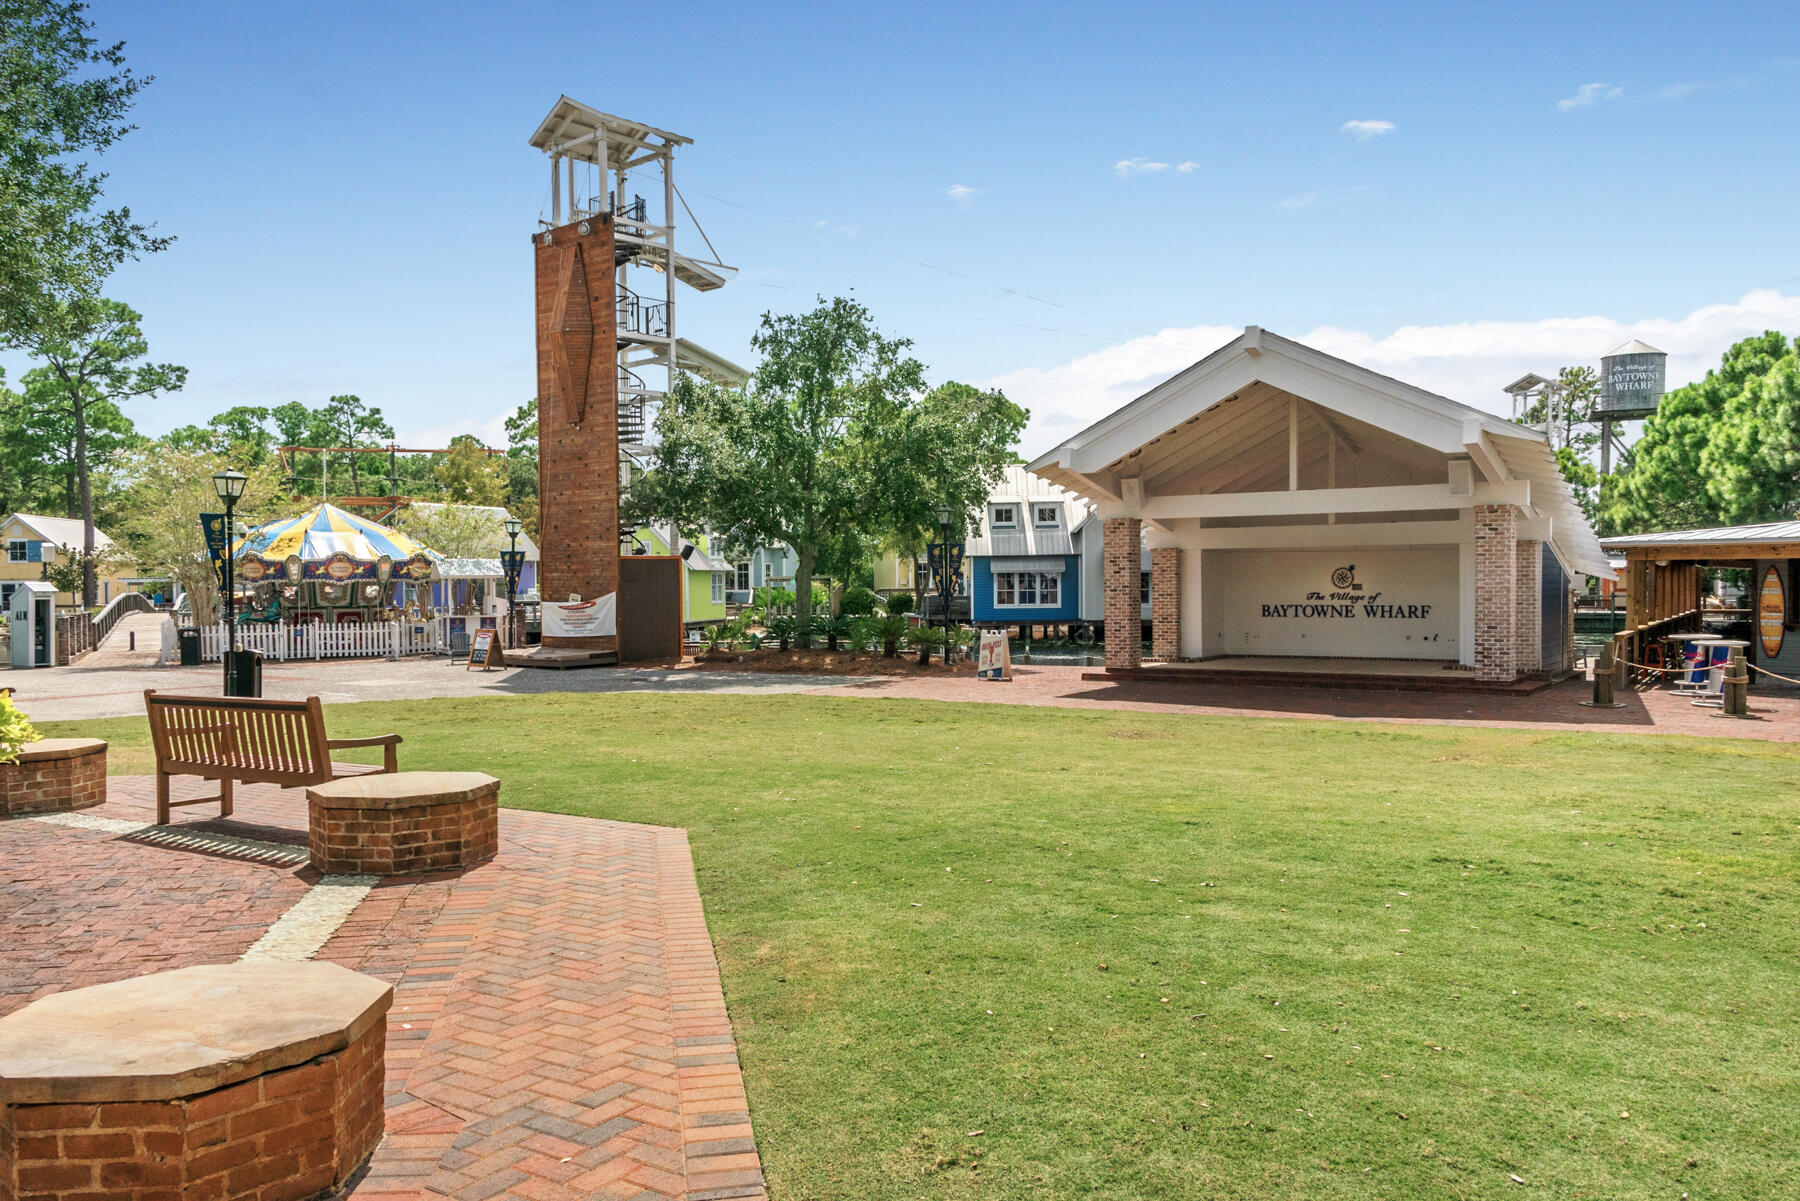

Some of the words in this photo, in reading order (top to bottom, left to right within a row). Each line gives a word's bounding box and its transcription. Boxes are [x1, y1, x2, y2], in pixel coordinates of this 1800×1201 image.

[1608, 372, 1659, 384] BAYTOWNE
[1615, 381, 1653, 391] WHARF
[1306, 592, 1326, 601] The
[1329, 592, 1365, 604] Village
[1367, 592, 1382, 604] of
[1261, 604, 1355, 618] BAYTOWNE
[1363, 604, 1432, 619] WHARF
